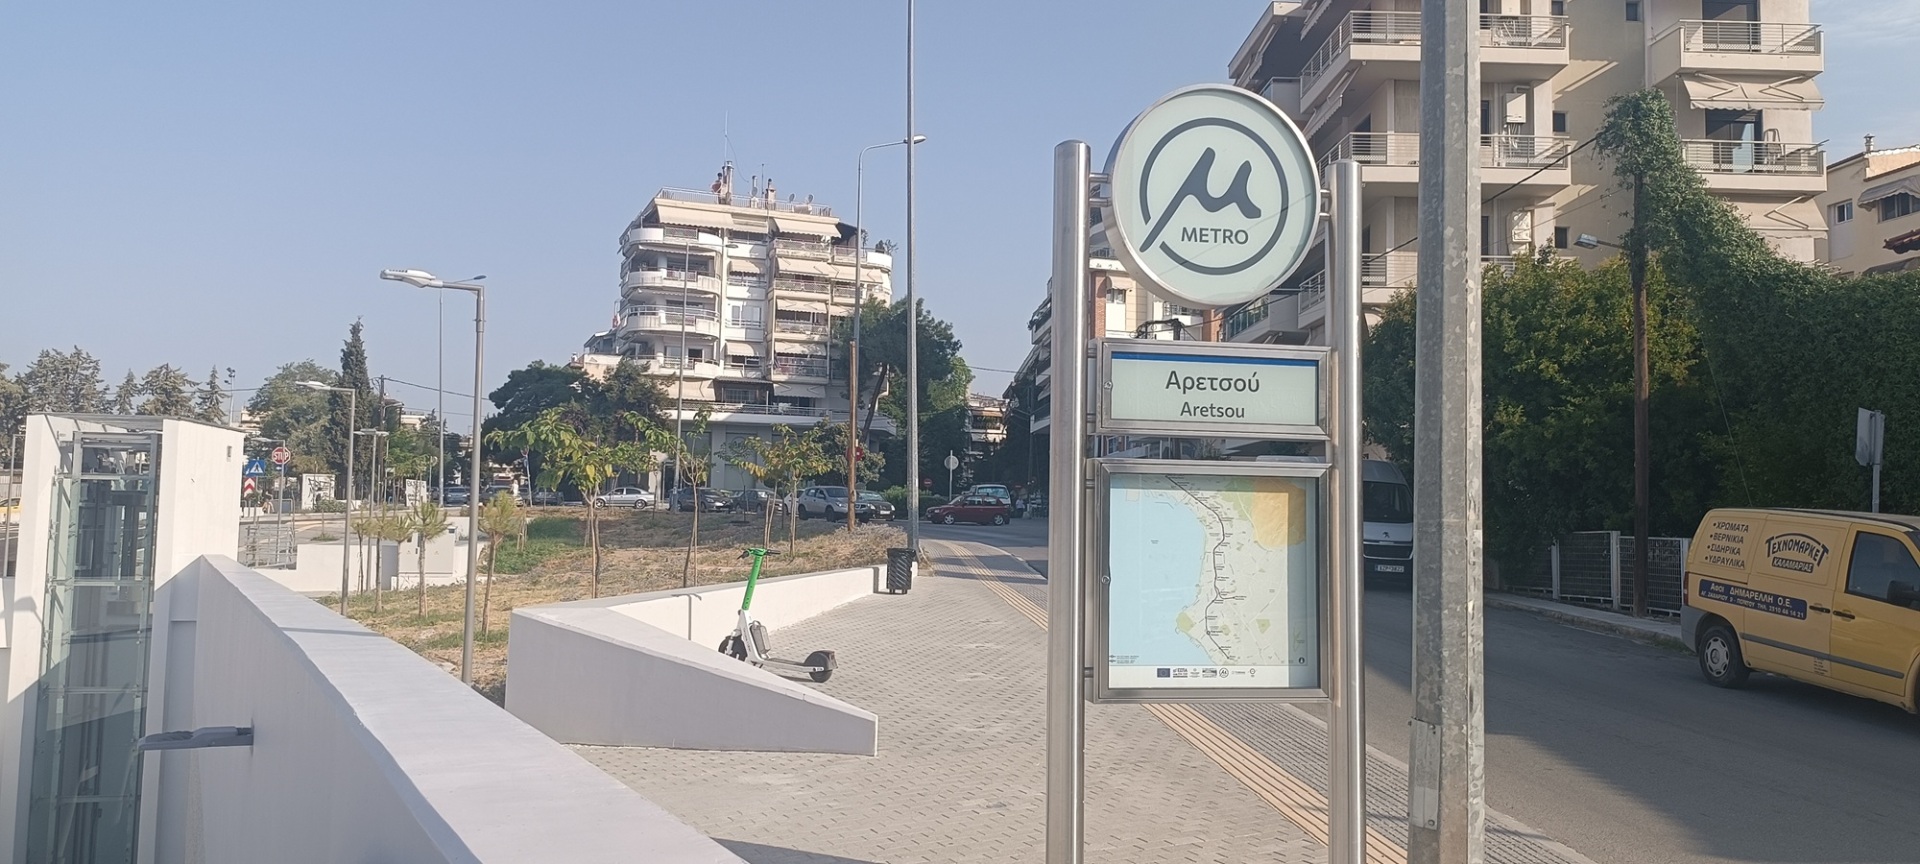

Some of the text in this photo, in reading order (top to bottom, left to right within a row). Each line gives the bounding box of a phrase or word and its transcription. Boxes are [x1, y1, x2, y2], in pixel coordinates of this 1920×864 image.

[1181, 227, 1249, 244] METRO
[1165, 370, 1260, 394] Αρετσού
[1180, 401, 1245, 418] Aretsou
[1715, 521, 1749, 533] ΧΡΩΜΑΤΑ
[1713, 532, 1744, 544] ΒΕΡΝΙΚΙΑ
[1710, 544, 1741, 556] ΣΙΔΗΡΙΚΑ
[1708, 555, 1745, 568] ΥΔΡΑΥΛΙΚΑ
[1773, 557, 1813, 573] ΚΑΛΑΜΑΡΙΑΣ
[1729, 586, 1774, 604] ΔΗΜΑΡΕΛΛΗ
